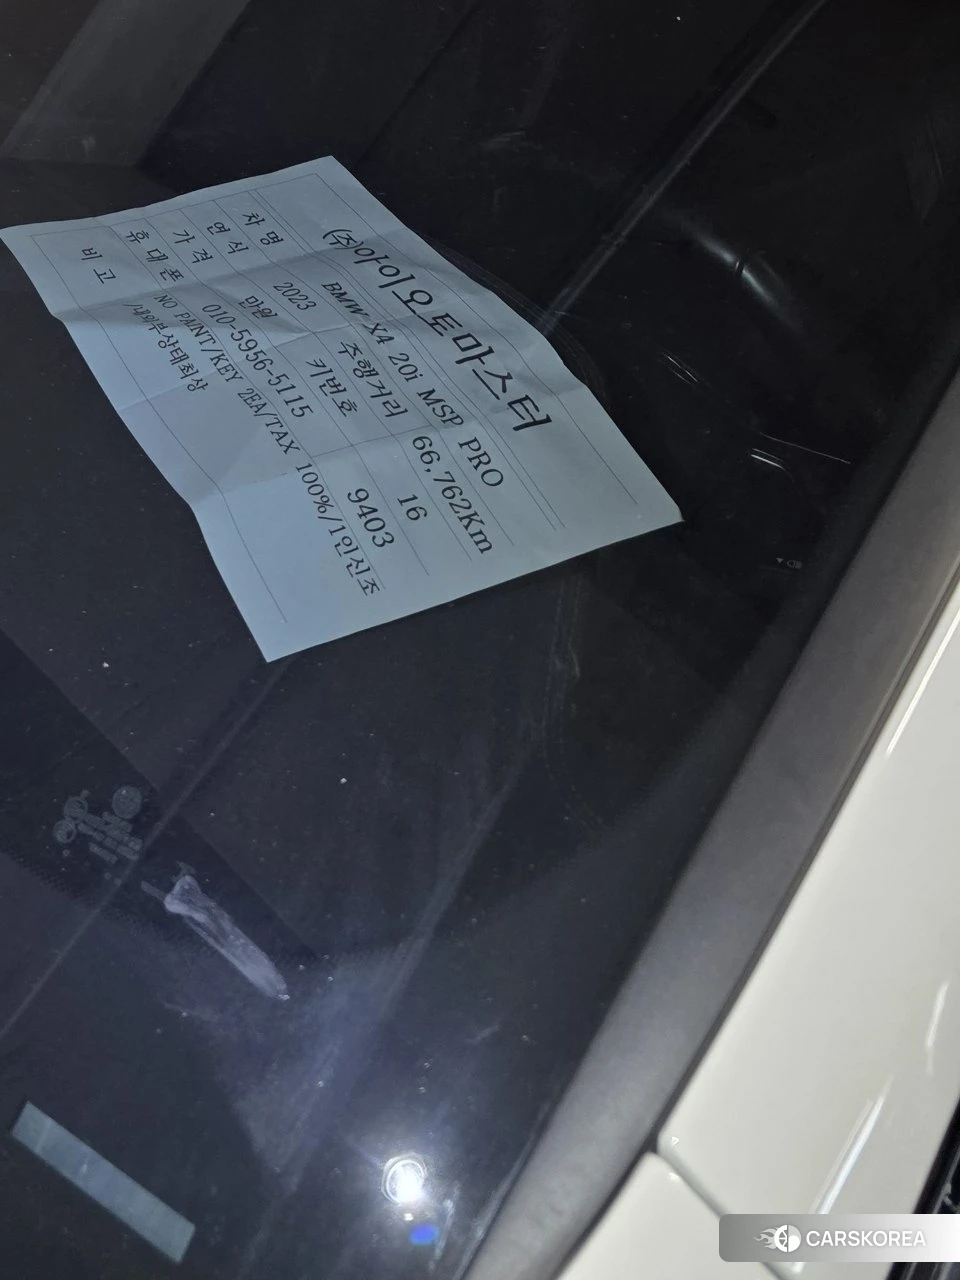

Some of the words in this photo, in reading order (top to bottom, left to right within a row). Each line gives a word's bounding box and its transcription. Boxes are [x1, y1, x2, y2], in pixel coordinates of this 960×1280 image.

[238, 294, 279, 319] 만원
[272, 281, 317, 311] 2023
[201, 303, 315, 418] 010-5956-5115
[305, 357, 358, 417] 키번호
[321, 281, 371, 318] BMW
[361, 322, 395, 345] X4
[387, 352, 424, 383] 20i
[416, 388, 465, 427] MSP
[458, 436, 504, 487] PRO
[337, 341, 409, 418] 주행거리
[153, 294, 179, 309] NO
[237, 387, 301, 455] 2EA/TAX
[296, 462, 381, 596] 100%/1인신조
[347, 487, 395, 548] 9403
[397, 494, 428, 521] 16
[412, 435, 493, 554] 66,762Km
